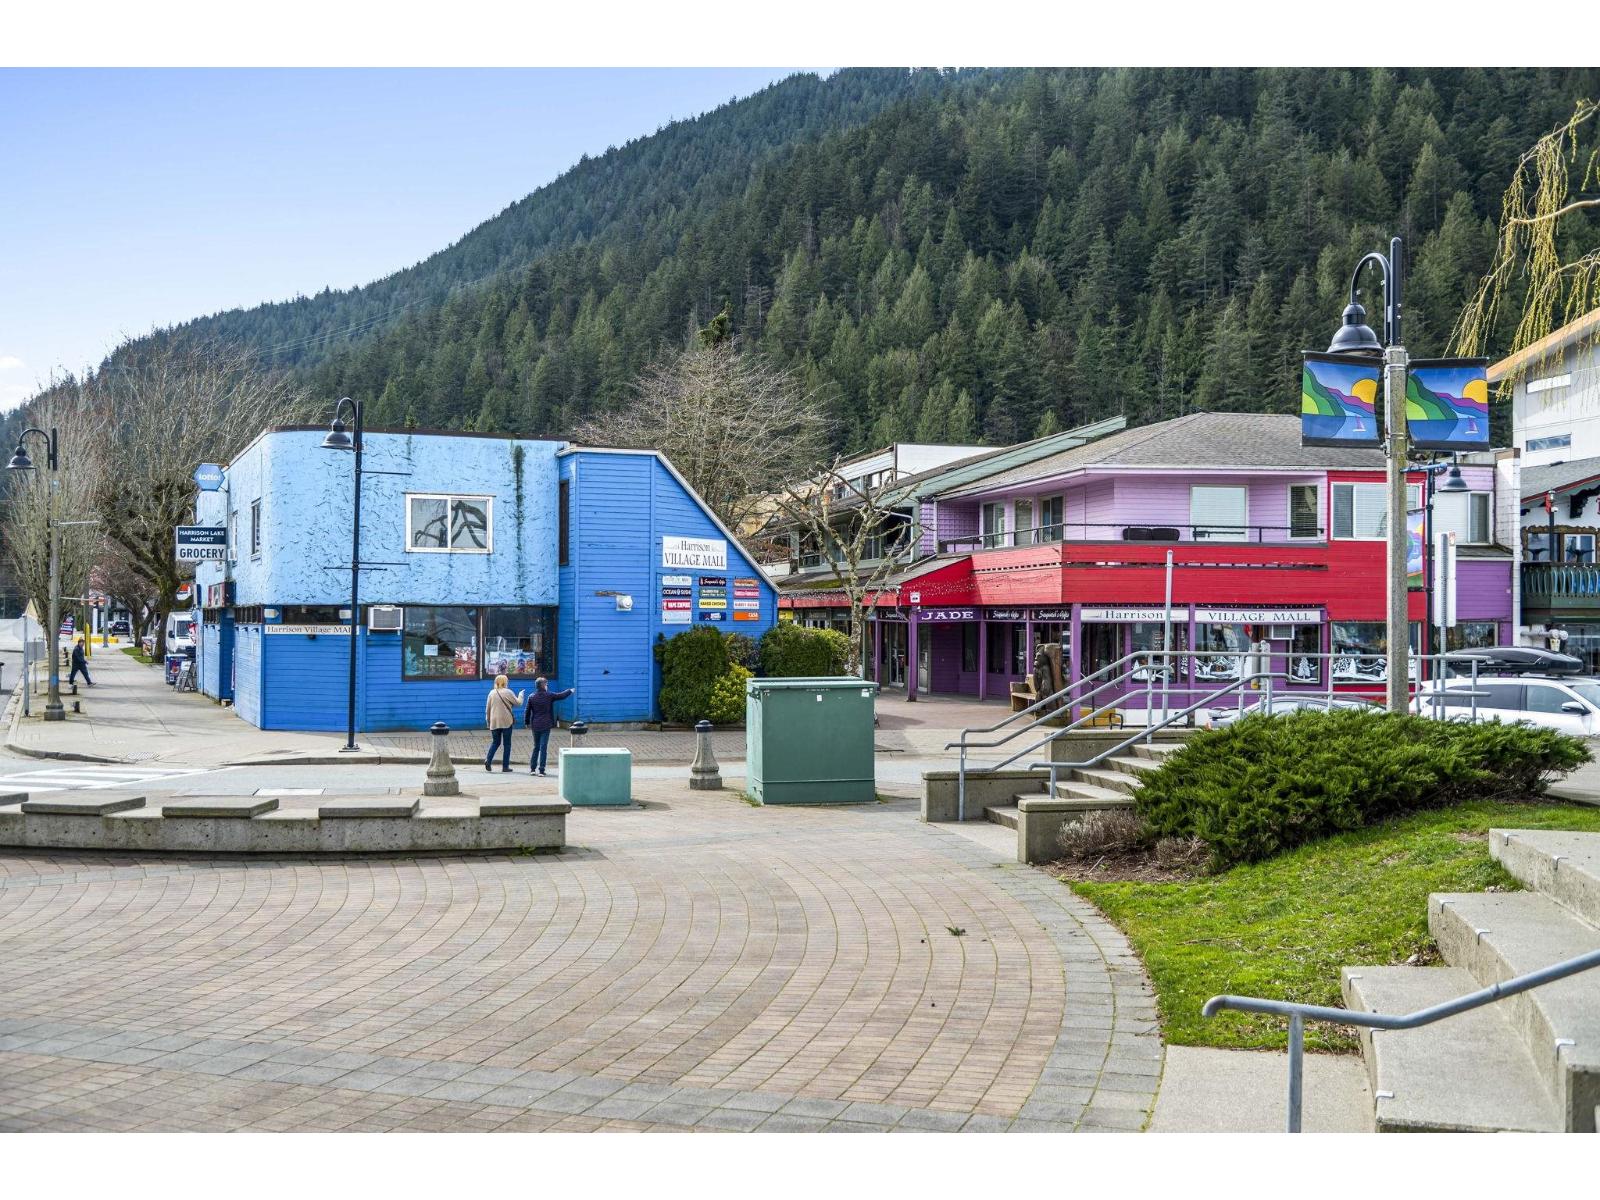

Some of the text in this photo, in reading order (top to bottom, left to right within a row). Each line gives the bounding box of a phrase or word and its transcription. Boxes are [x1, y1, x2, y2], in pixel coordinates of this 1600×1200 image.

[681, 540, 711, 552] Harrison
[180, 548, 225, 558] GROCERY
[664, 552, 726, 567] VILLAGE MALL
[921, 611, 974, 620] JADE
[1105, 610, 1163, 619] Harrison
[1208, 612, 1311, 621] VILLAGE MALL
[304, 626, 332, 634] Village
